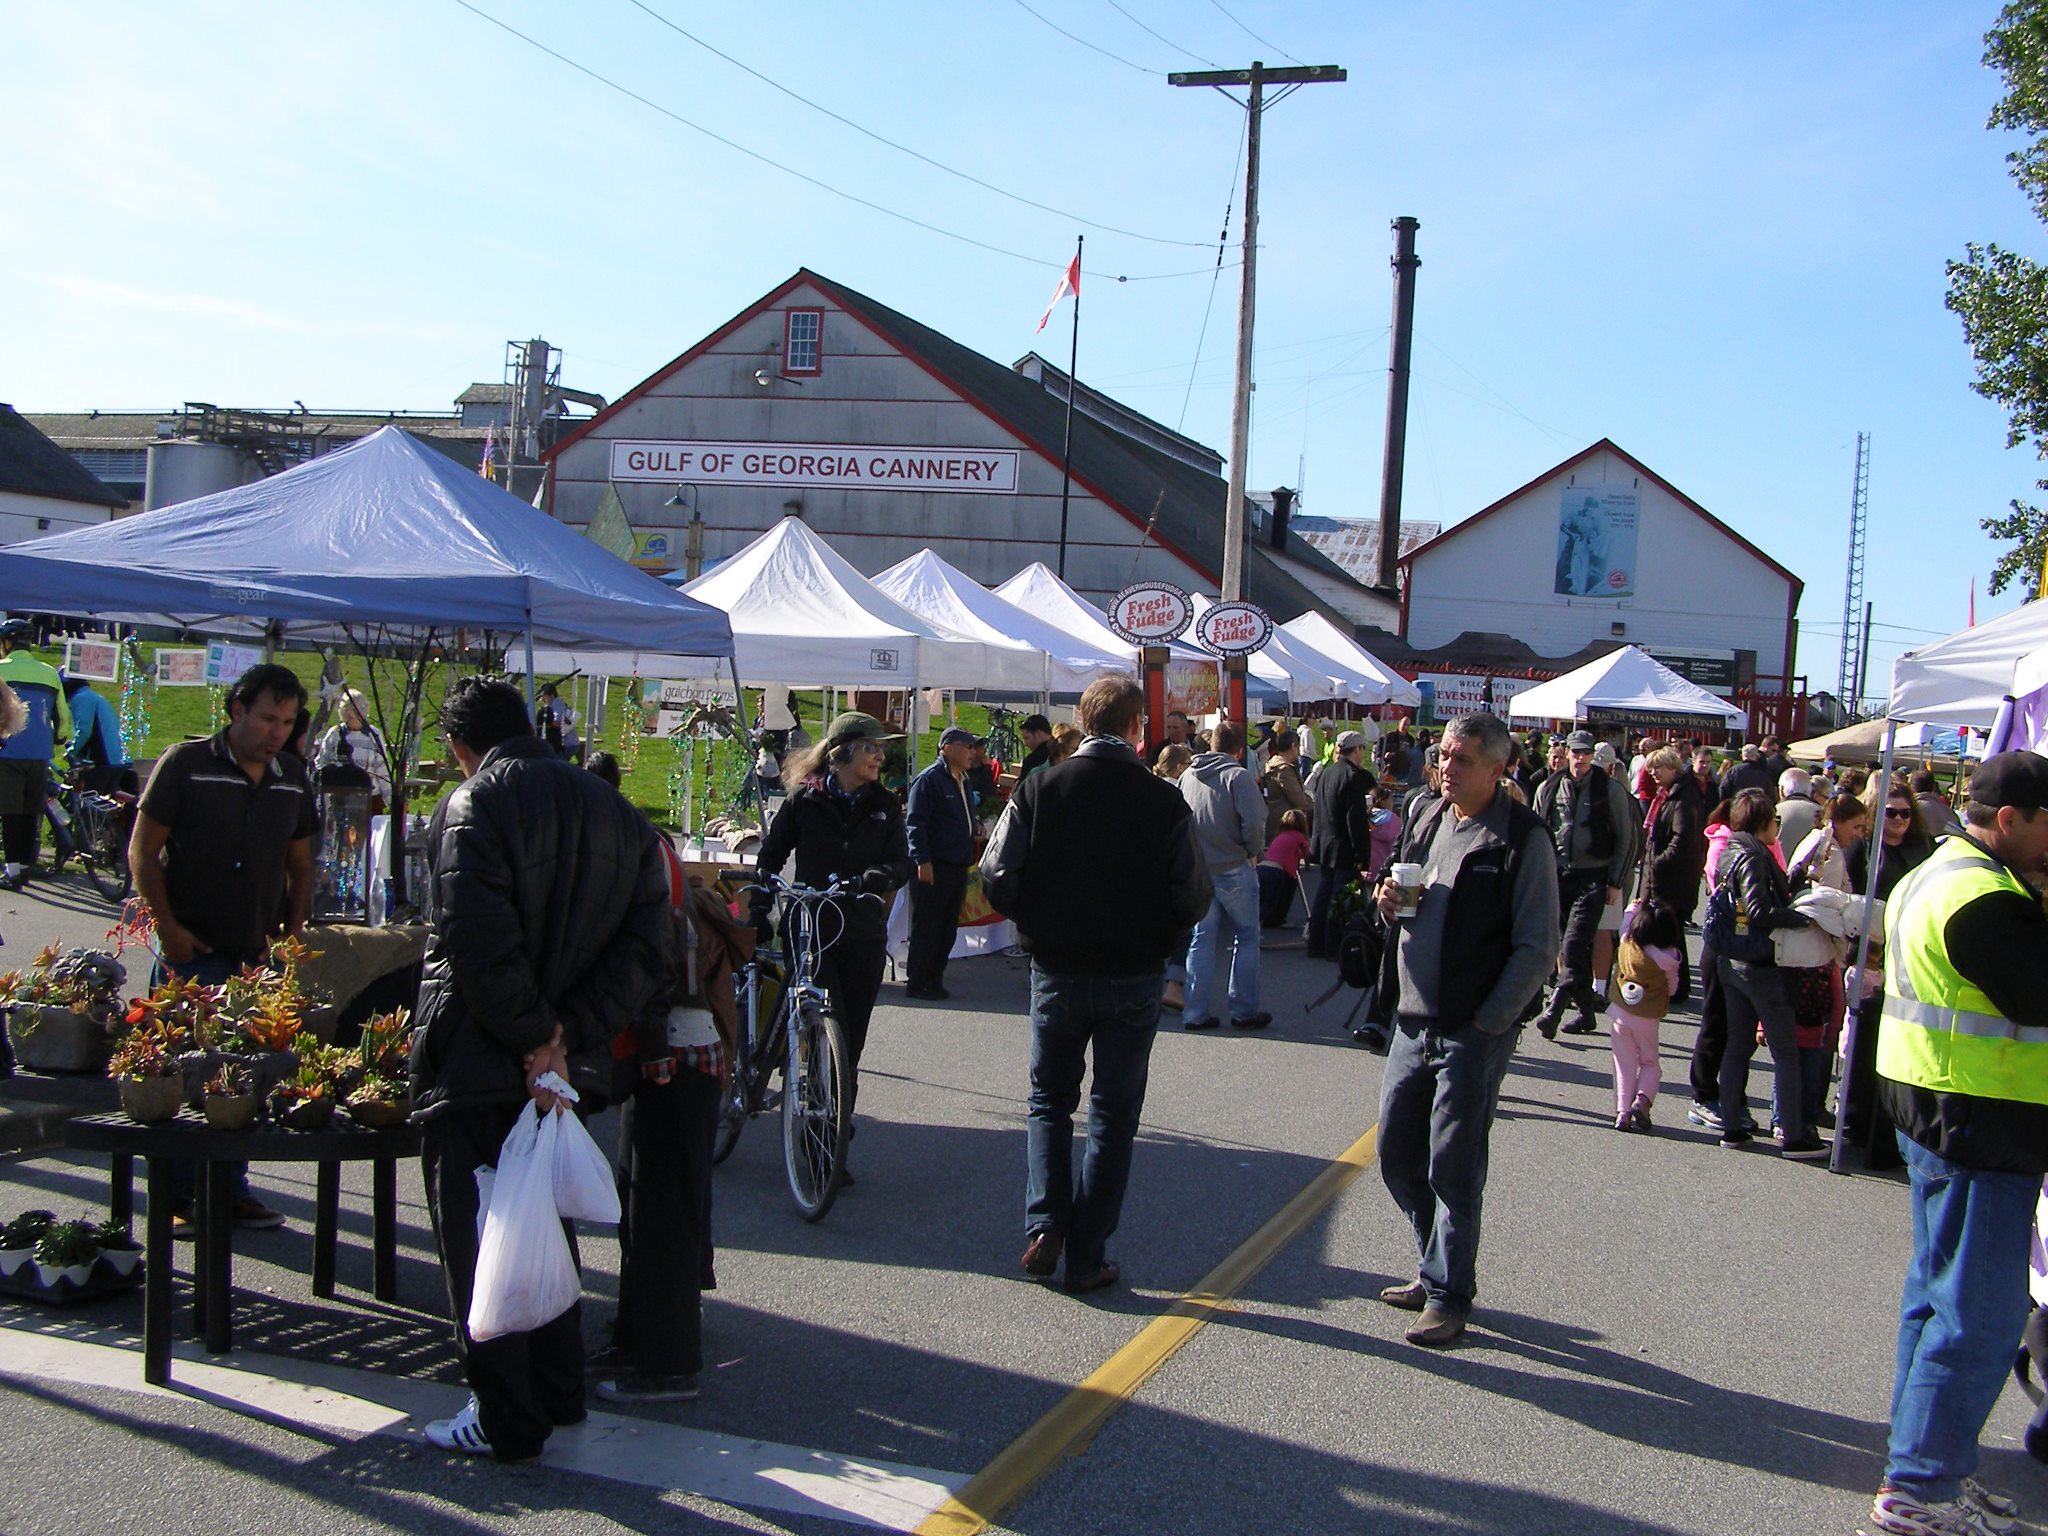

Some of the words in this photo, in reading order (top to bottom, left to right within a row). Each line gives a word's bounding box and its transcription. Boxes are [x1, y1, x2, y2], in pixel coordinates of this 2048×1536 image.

[628, 451, 693, 472] GULF
[701, 453, 734, 473] OF
[742, 454, 861, 477] GEORGIA
[869, 457, 999, 481] CANNERY
[1127, 594, 1171, 615] Fresh
[1126, 610, 1175, 631] Fudge
[1214, 612, 1253, 631] Fresh
[1111, 622, 1139, 644] Quality
[1141, 637, 1161, 645] Sure
[1212, 626, 1256, 644] Fudge
[1200, 637, 1224, 656] Quality
[1459, 680, 1500, 690] WELCME
[1591, 711, 1626, 721] LOWER
[1629, 713, 1686, 726] MAINLAND
[1688, 719, 1721, 728] HONEY
